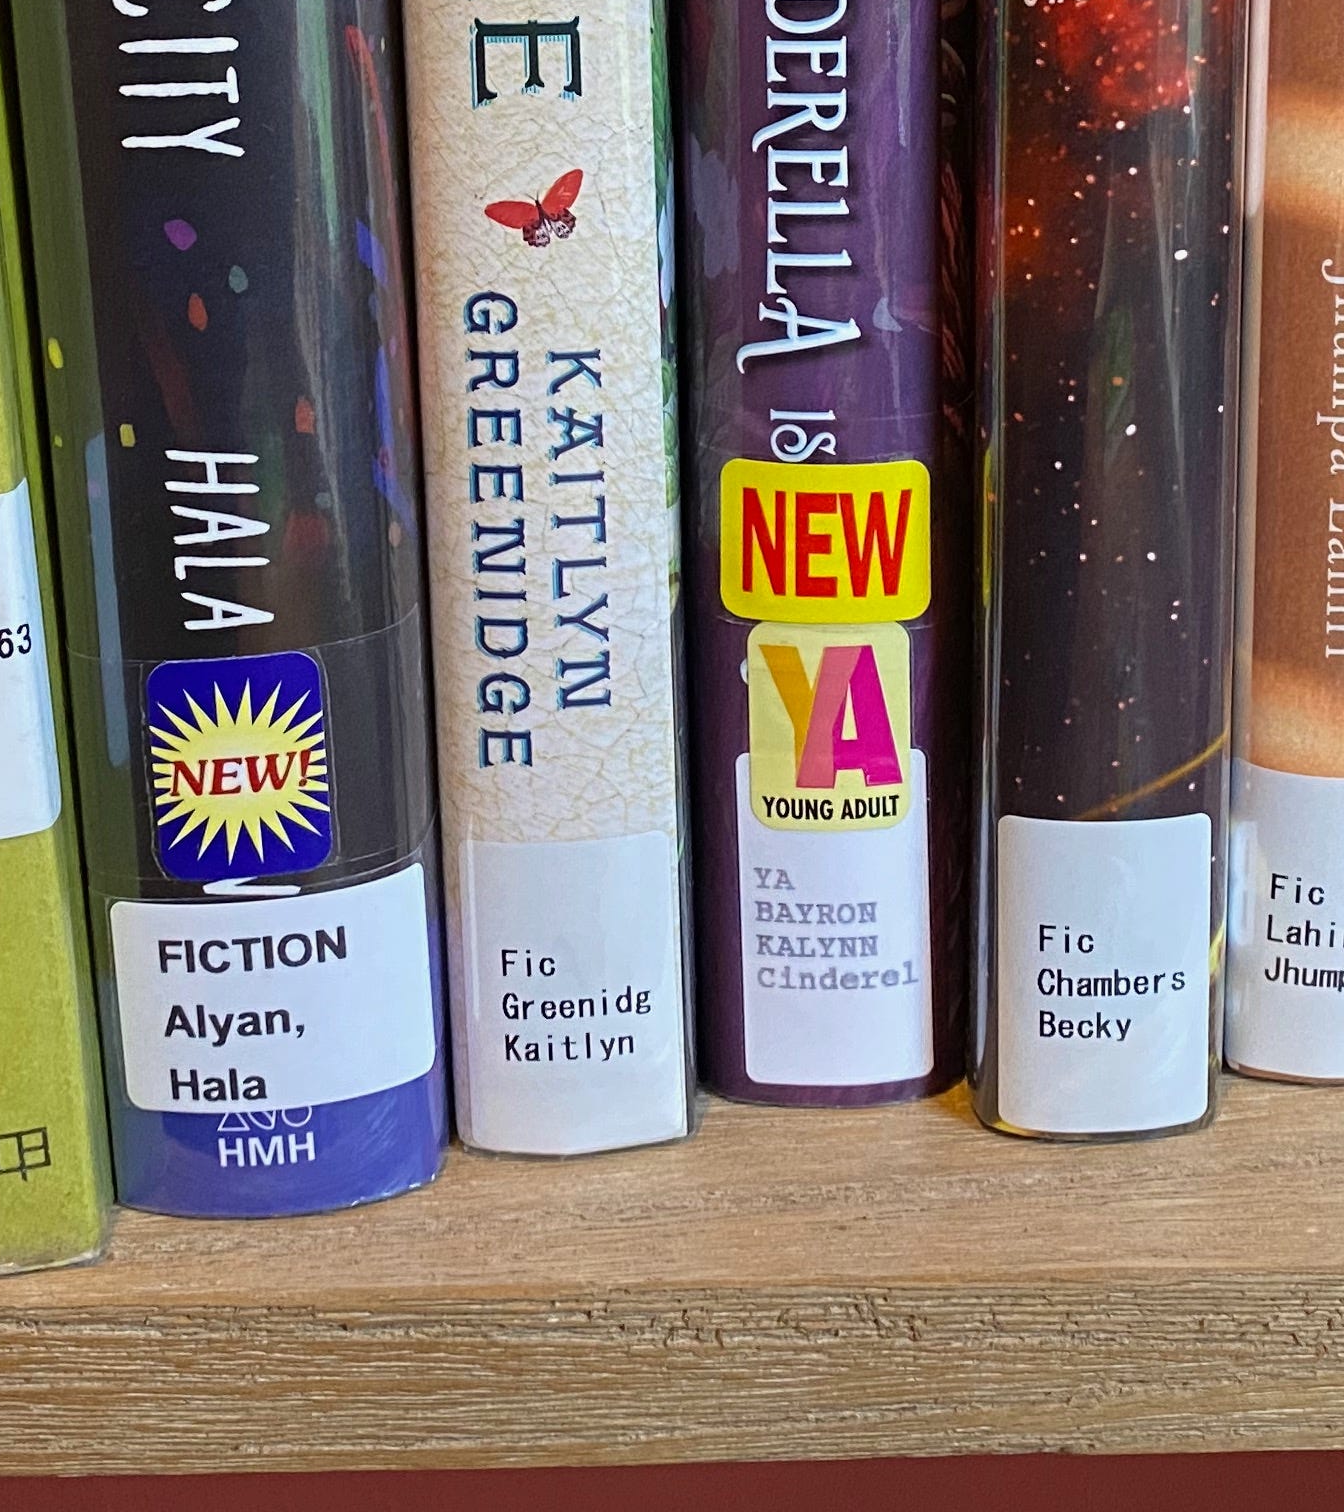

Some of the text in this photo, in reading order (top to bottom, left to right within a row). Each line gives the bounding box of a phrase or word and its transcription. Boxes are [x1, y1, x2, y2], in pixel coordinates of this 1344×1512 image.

[163, 448, 276, 632] HALA
[463, 289, 534, 770] GREENIDGE
[546, 348, 612, 711] KAITLYN
[741, 487, 913, 599] NEW
[757, 643, 904, 790] YA
[169, 748, 315, 797] NEW!
[762, 793, 901, 821] YOUNG ADULT
[752, 867, 796, 890] YA
[1270, 872, 1325, 906] Fic
[754, 900, 878, 924] BAYRON
[157, 925, 347, 974] FICTION
[755, 934, 879, 959] KALYNN
[1038, 923, 1095, 955] Fic
[501, 949, 556, 978] Fic
[757, 960, 920, 990] Cinderel
[1036, 967, 1187, 998] Chambers
[501, 985, 653, 1021] Greenidg
[163, 1004, 306, 1048] Alyan,
[1038, 1009, 1132, 1042] Becky
[504, 1032, 635, 1063] Kaitlyn
[169, 1067, 268, 1102] Hala
[217, 1130, 316, 1169] HMH
